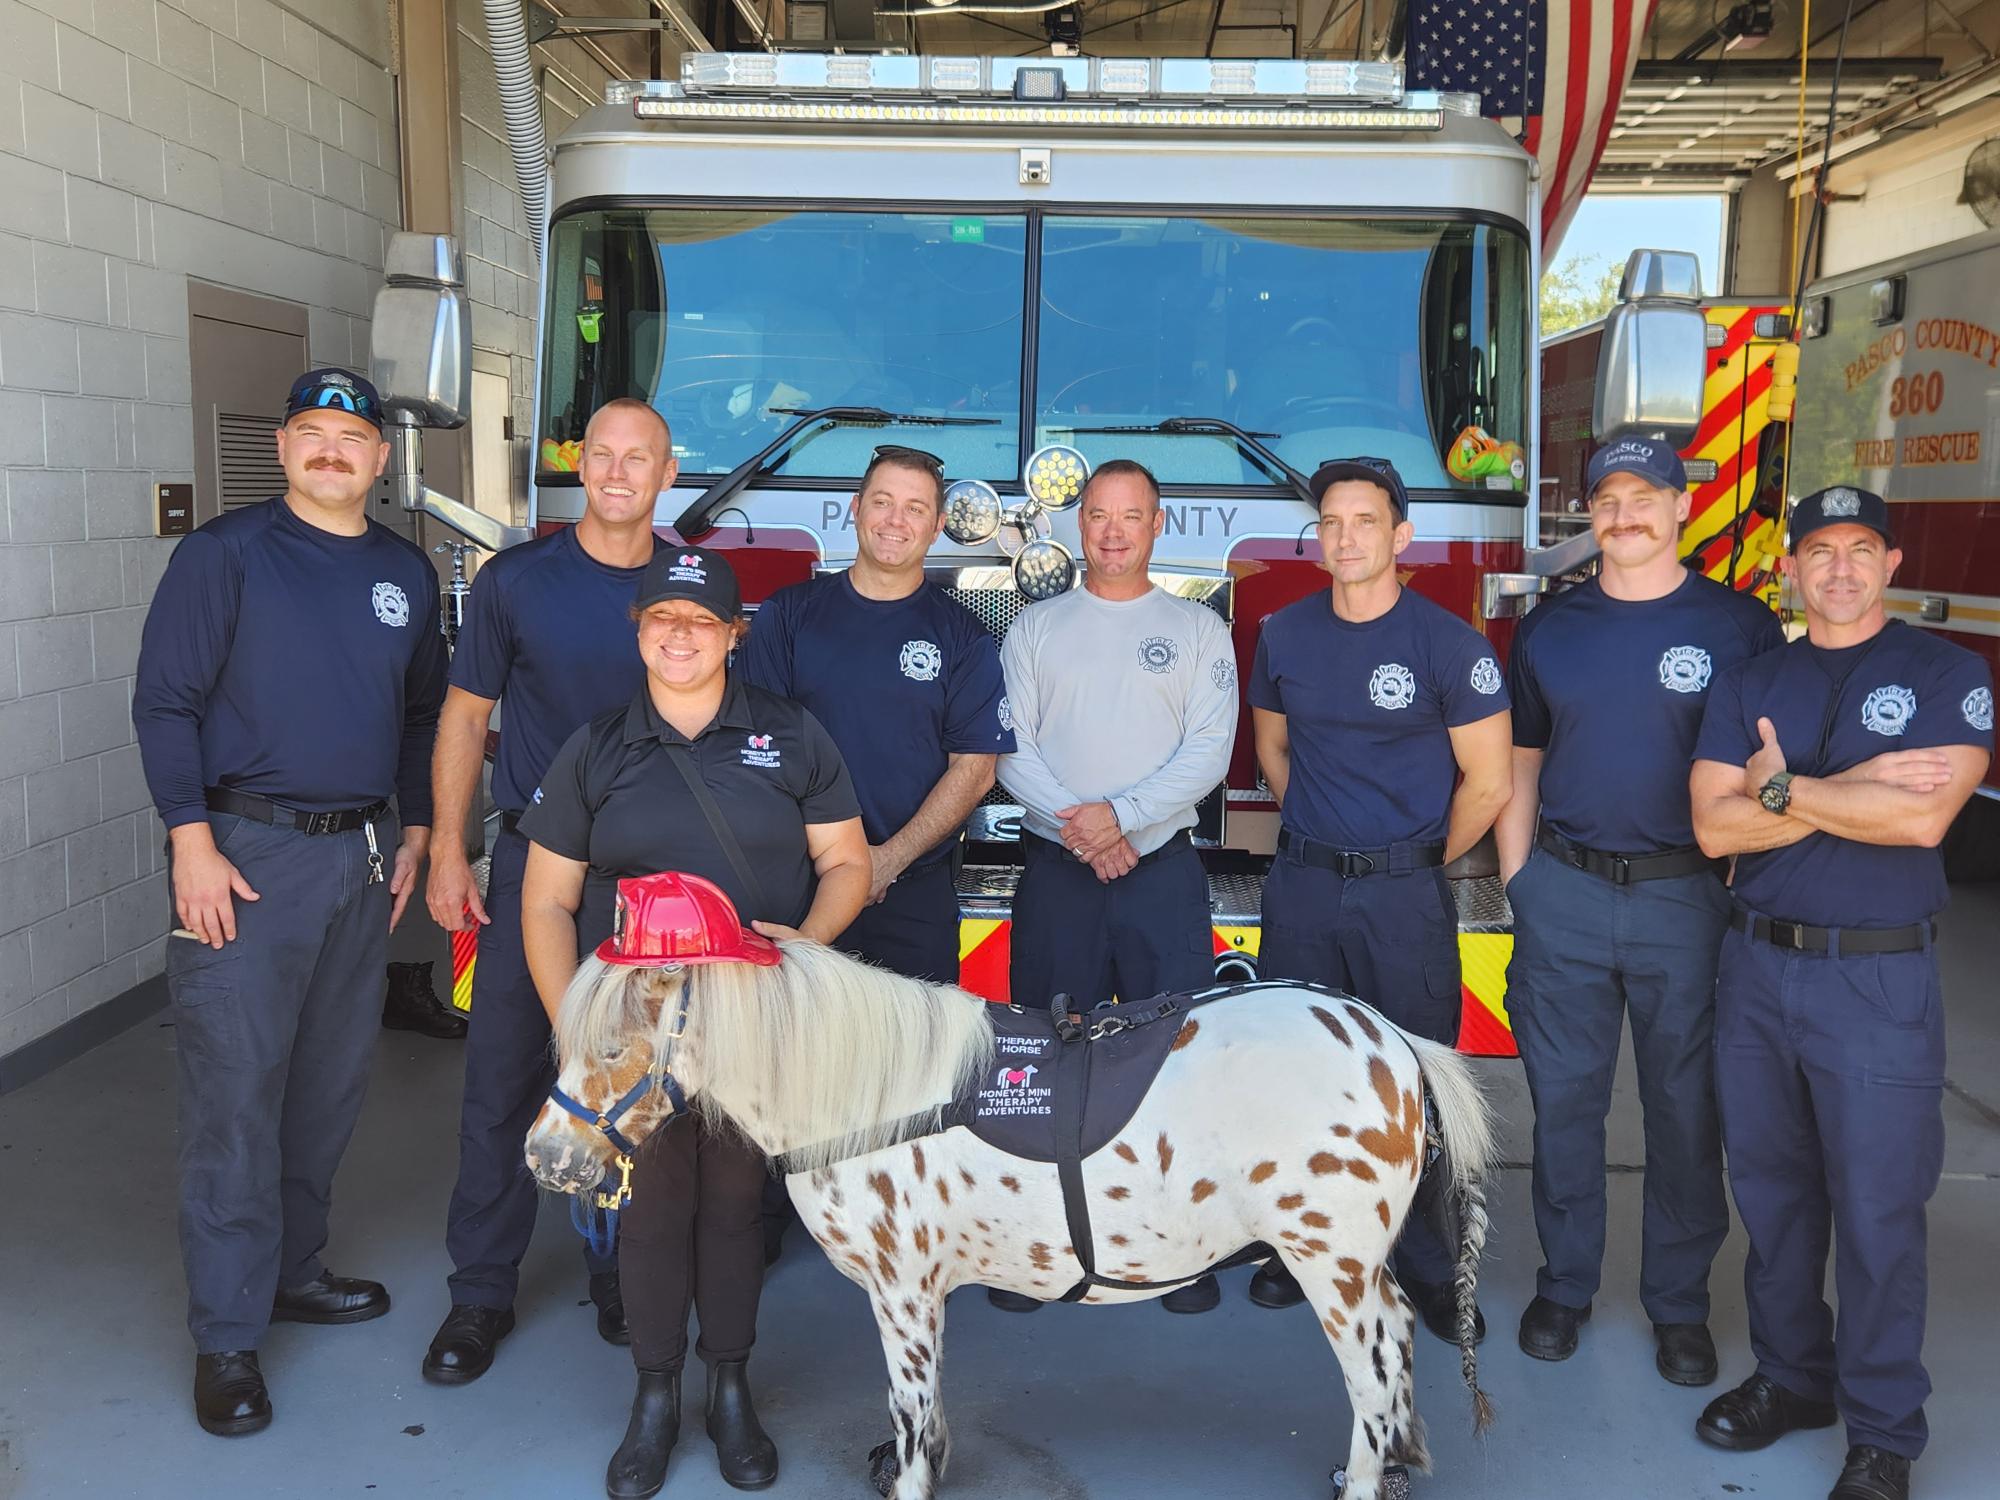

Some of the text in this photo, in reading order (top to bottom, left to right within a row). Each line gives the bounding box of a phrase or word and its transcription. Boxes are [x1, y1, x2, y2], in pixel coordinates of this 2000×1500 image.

[1844, 319, 2000, 395] PASCO COUNTY
[1889, 369, 1945, 421] 360
[1854, 431, 1981, 468] FIRE RESCUE
[1165, 504, 1238, 537] NTY
[996, 1036, 1049, 1046] THERAPY
[1002, 1045, 1041, 1054] HORSE
[979, 1087, 1051, 1098] HONEY'S MINI
[988, 1097, 1042, 1107] THERAPY
[978, 1105, 1052, 1116] ADVENTURES
